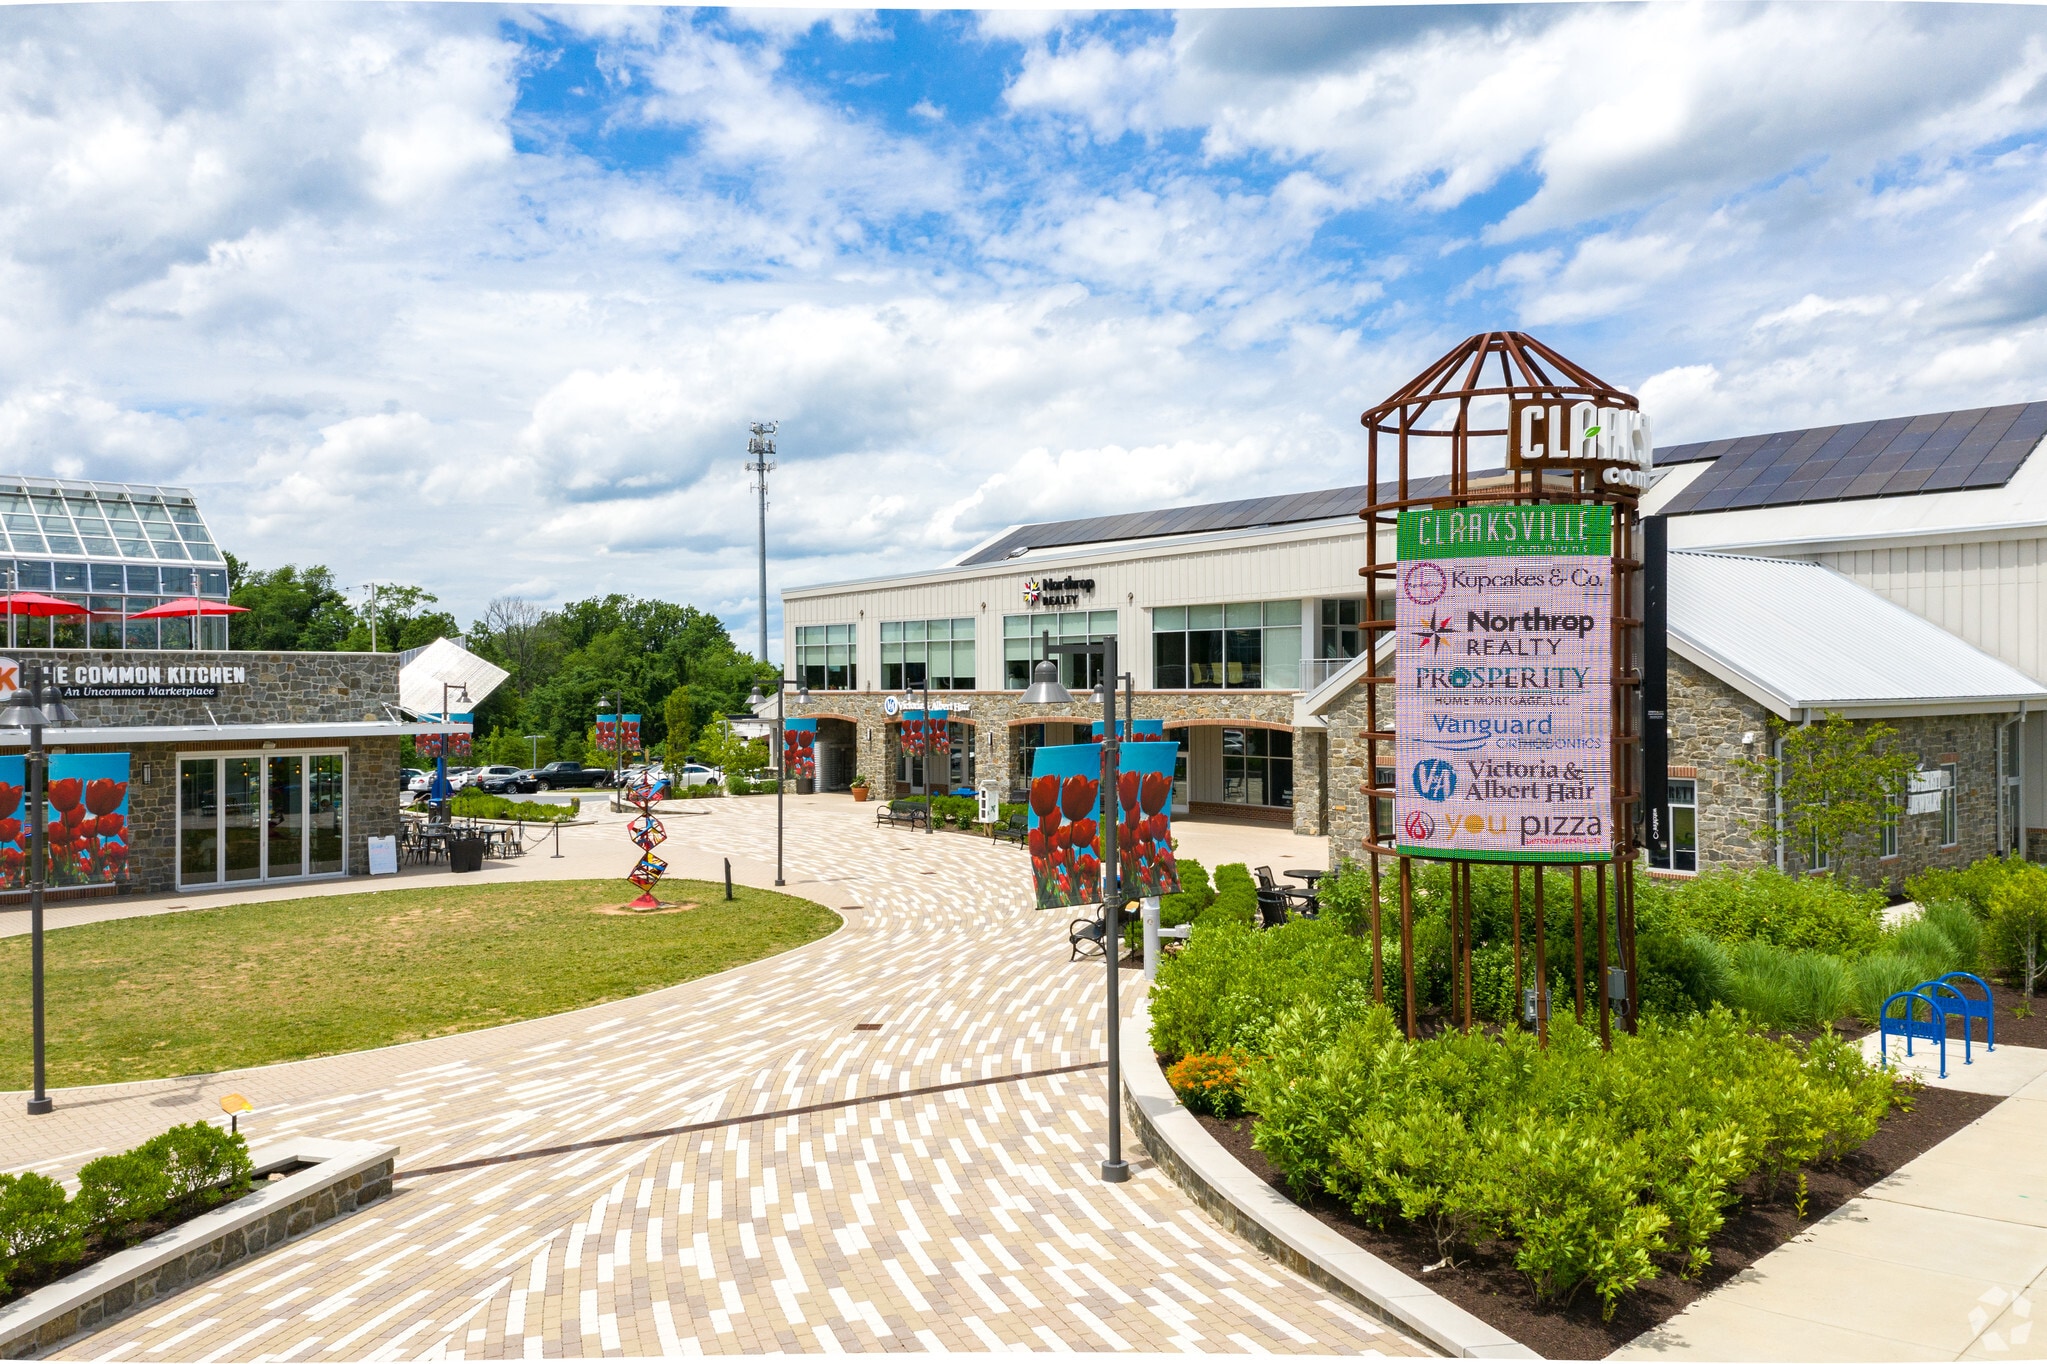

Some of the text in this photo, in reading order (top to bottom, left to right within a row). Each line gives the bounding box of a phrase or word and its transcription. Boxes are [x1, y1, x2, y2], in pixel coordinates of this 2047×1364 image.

[1419, 511, 1589, 545] CLARKSVILLE
[1042, 575, 1095, 593] Northrop
[1452, 568, 1545, 594] Kupcakes
[1549, 568, 1568, 587] &
[1571, 568, 1603, 587] Co.
[1042, 594, 1078, 606] REALTY
[1467, 607, 1594, 639] Northrop
[1467, 638, 1561, 656] REALTY
[75, 666, 161, 684] COMMON
[167, 666, 245, 684] KITCHEN
[1416, 667, 1591, 689] PROSPERITY
[64, 687, 215, 698] An Uncommon Marketplace
[1435, 696, 1570, 707] HOME MORTGAGE, LLC
[1433, 714, 1553, 736] Vanguard
[1466, 759, 1584, 780] Victoria &
[1465, 780, 1595, 803] Albert Hair
[1444, 813, 1601, 846] you pizza
